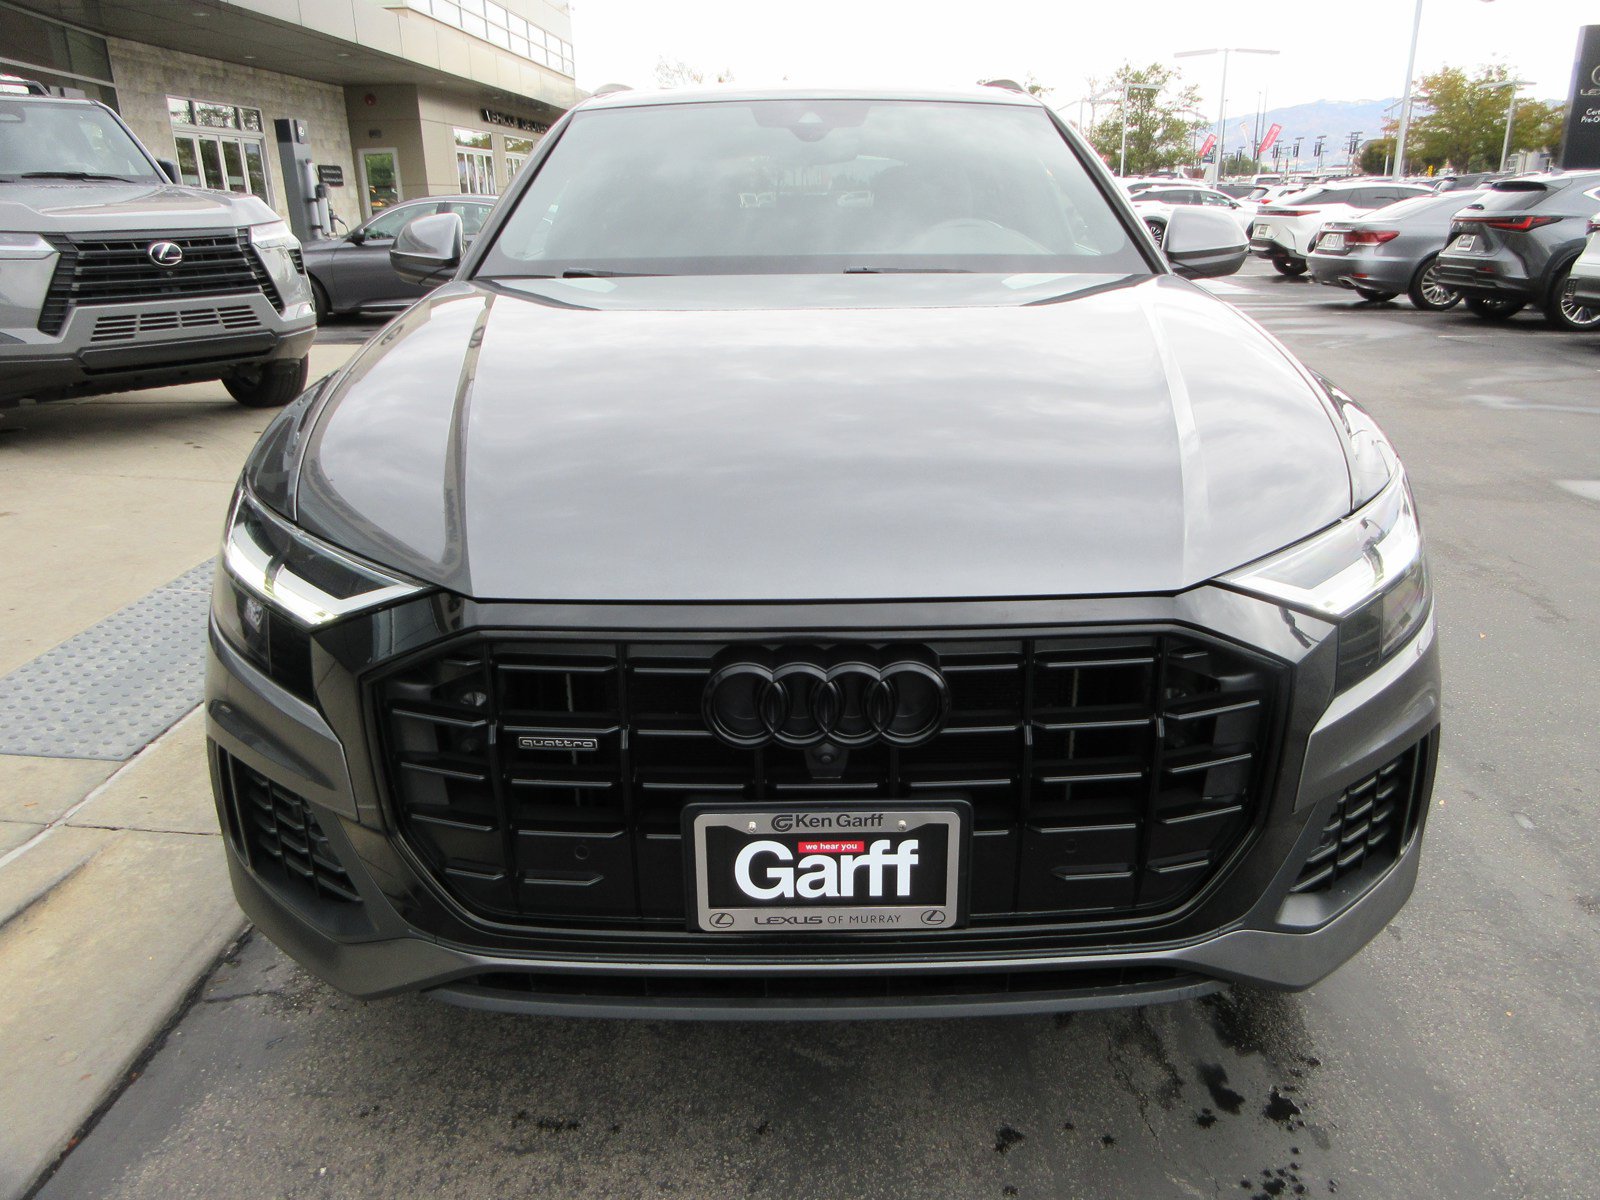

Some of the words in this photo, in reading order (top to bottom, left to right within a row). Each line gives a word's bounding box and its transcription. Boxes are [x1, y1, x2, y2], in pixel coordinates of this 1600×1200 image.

[522, 739, 593, 748] quattro
[795, 813, 832, 829] Ken
[835, 813, 884, 828] Garff
[820, 841, 838, 850] hear
[840, 842, 858, 852] you
[734, 839, 919, 900] Garff
[754, 916, 823, 925] LEXUS
[827, 916, 844, 924] OF
[849, 914, 901, 924] MURRAY
